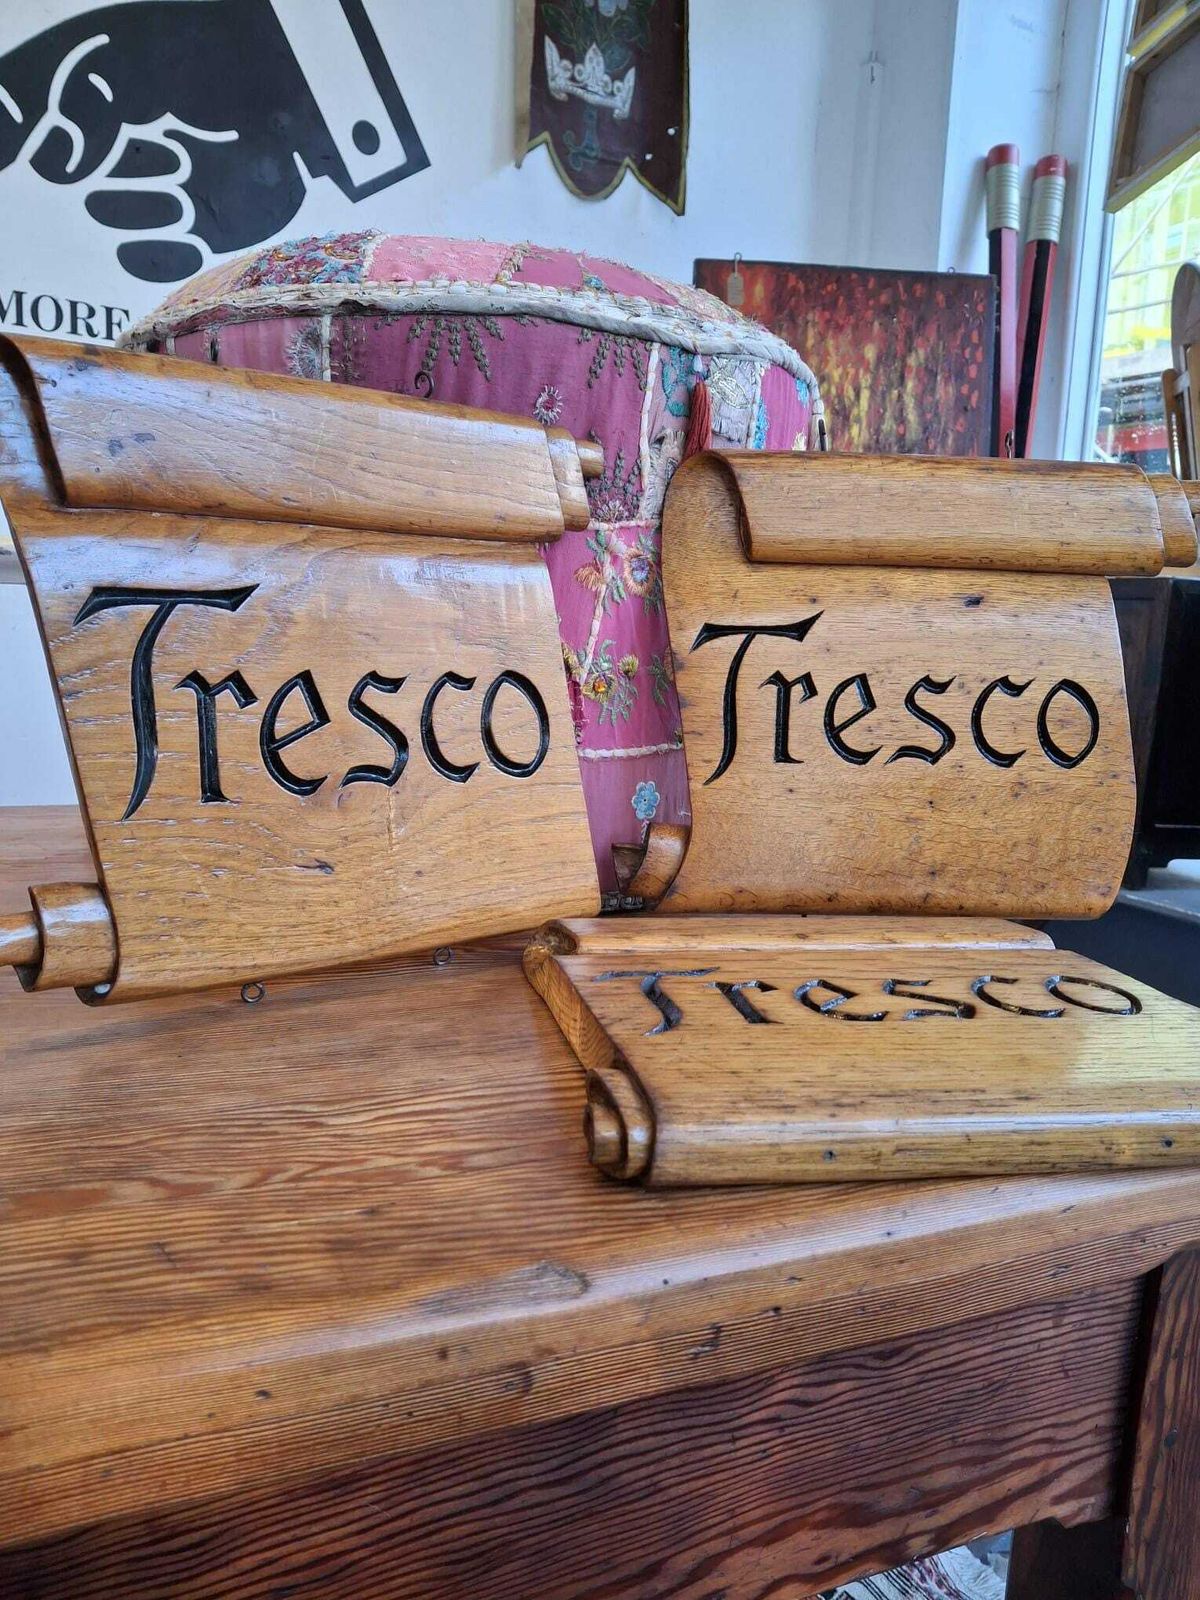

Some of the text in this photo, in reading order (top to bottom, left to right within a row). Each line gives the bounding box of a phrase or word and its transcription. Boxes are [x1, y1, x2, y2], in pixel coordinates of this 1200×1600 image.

[72, 582, 550, 821] Tresco
[688, 609, 1100, 785] Tresco
[592, 966, 1144, 1036] Tresco
